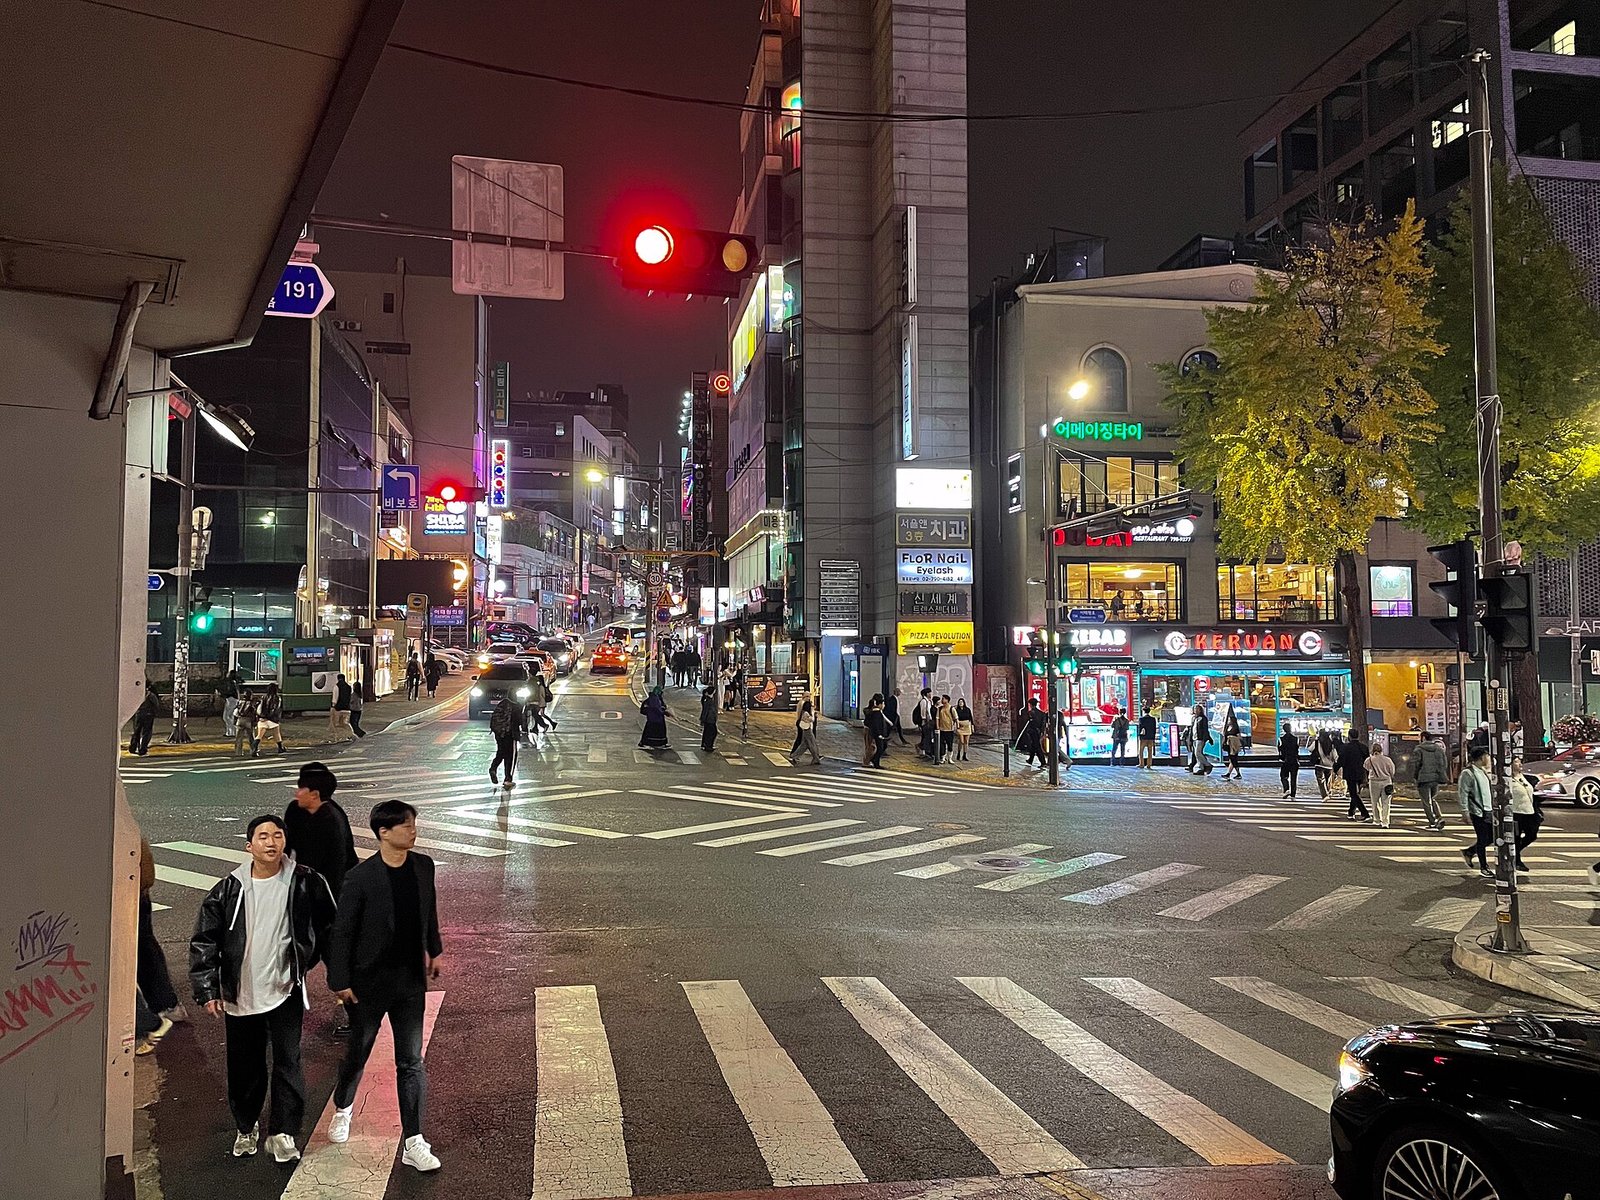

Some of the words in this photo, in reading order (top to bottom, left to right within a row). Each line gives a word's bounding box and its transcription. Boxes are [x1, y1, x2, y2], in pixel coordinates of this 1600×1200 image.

[284, 280, 315, 299] 191
[1056, 421, 1143, 440] 어메이징타이
[384, 497, 418, 509] 비보호
[900, 518, 928, 529] 서울앤
[930, 519, 967, 541] 치과
[905, 531, 924, 541] 3층
[916, 566, 953, 575] Eyelash
[651, 575, 660, 583] 30
[910, 632, 929, 640] PIZZA
[931, 632, 970, 640] REVOLUTION
